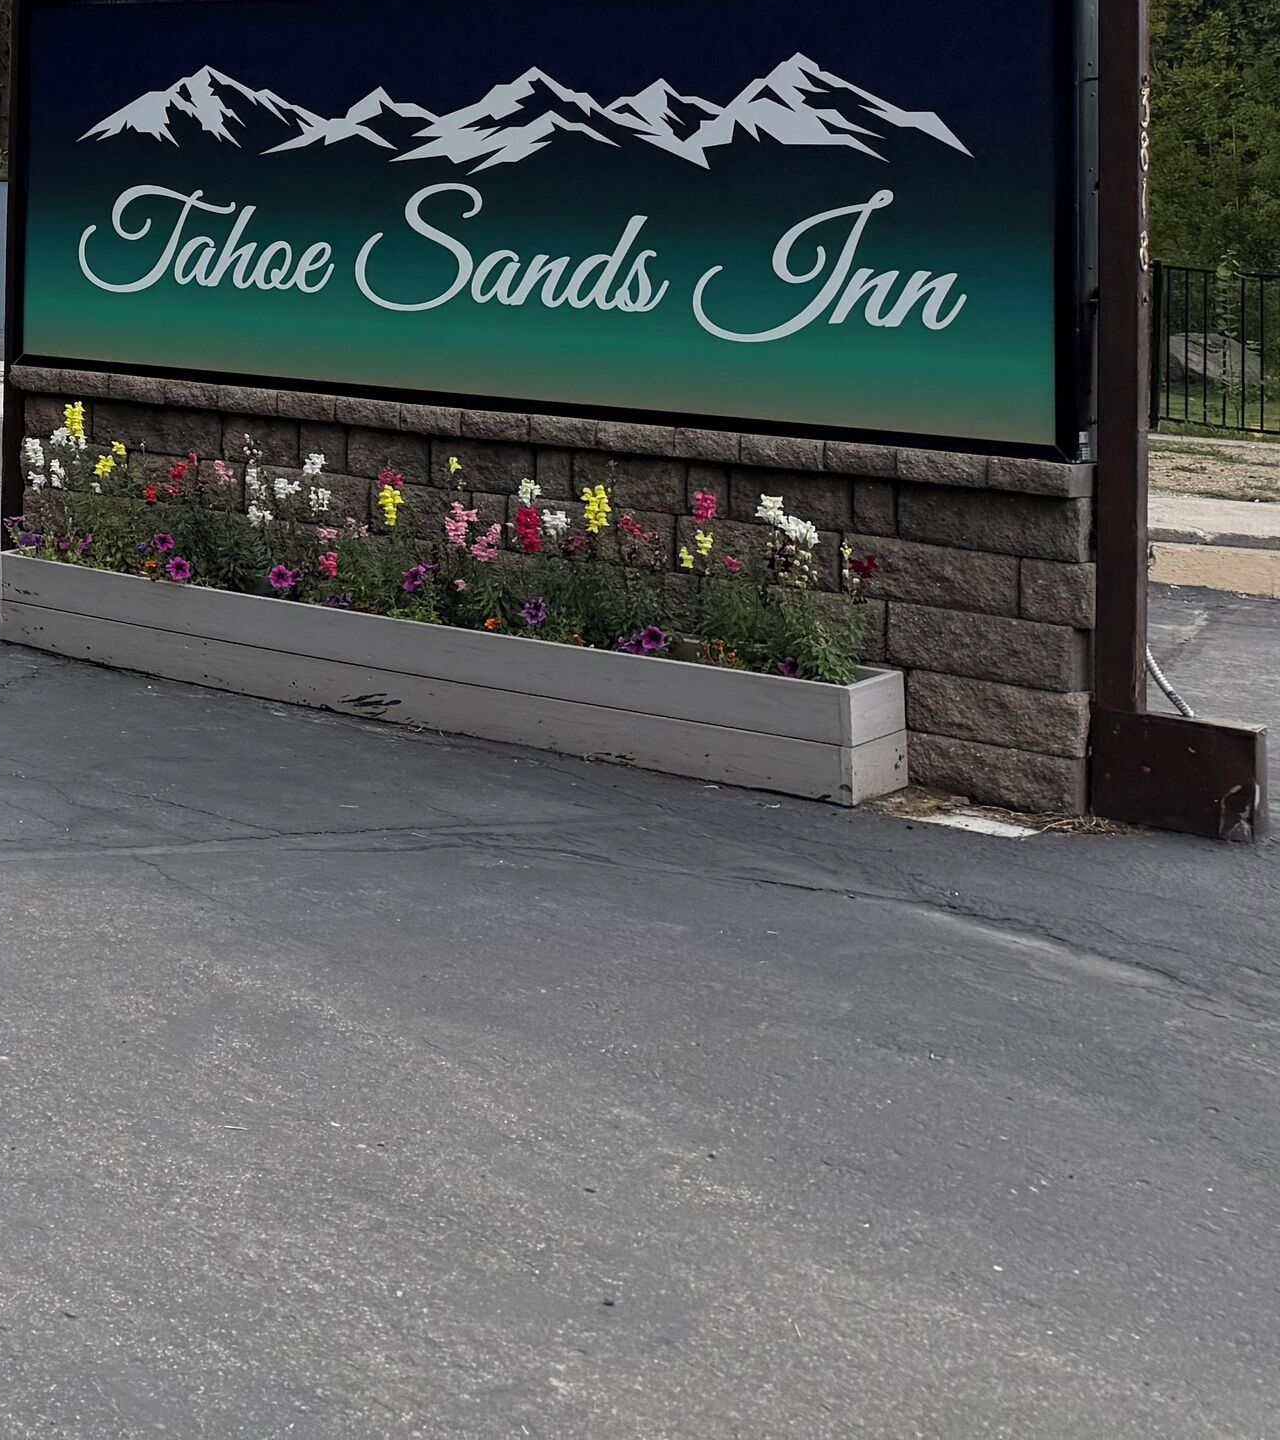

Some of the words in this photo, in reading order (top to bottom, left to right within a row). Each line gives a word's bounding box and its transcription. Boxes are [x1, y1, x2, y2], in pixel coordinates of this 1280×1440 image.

[78, 184, 335, 294] Tahoe
[354, 182, 670, 312] Sands
[692, 189, 967, 343] Inn
